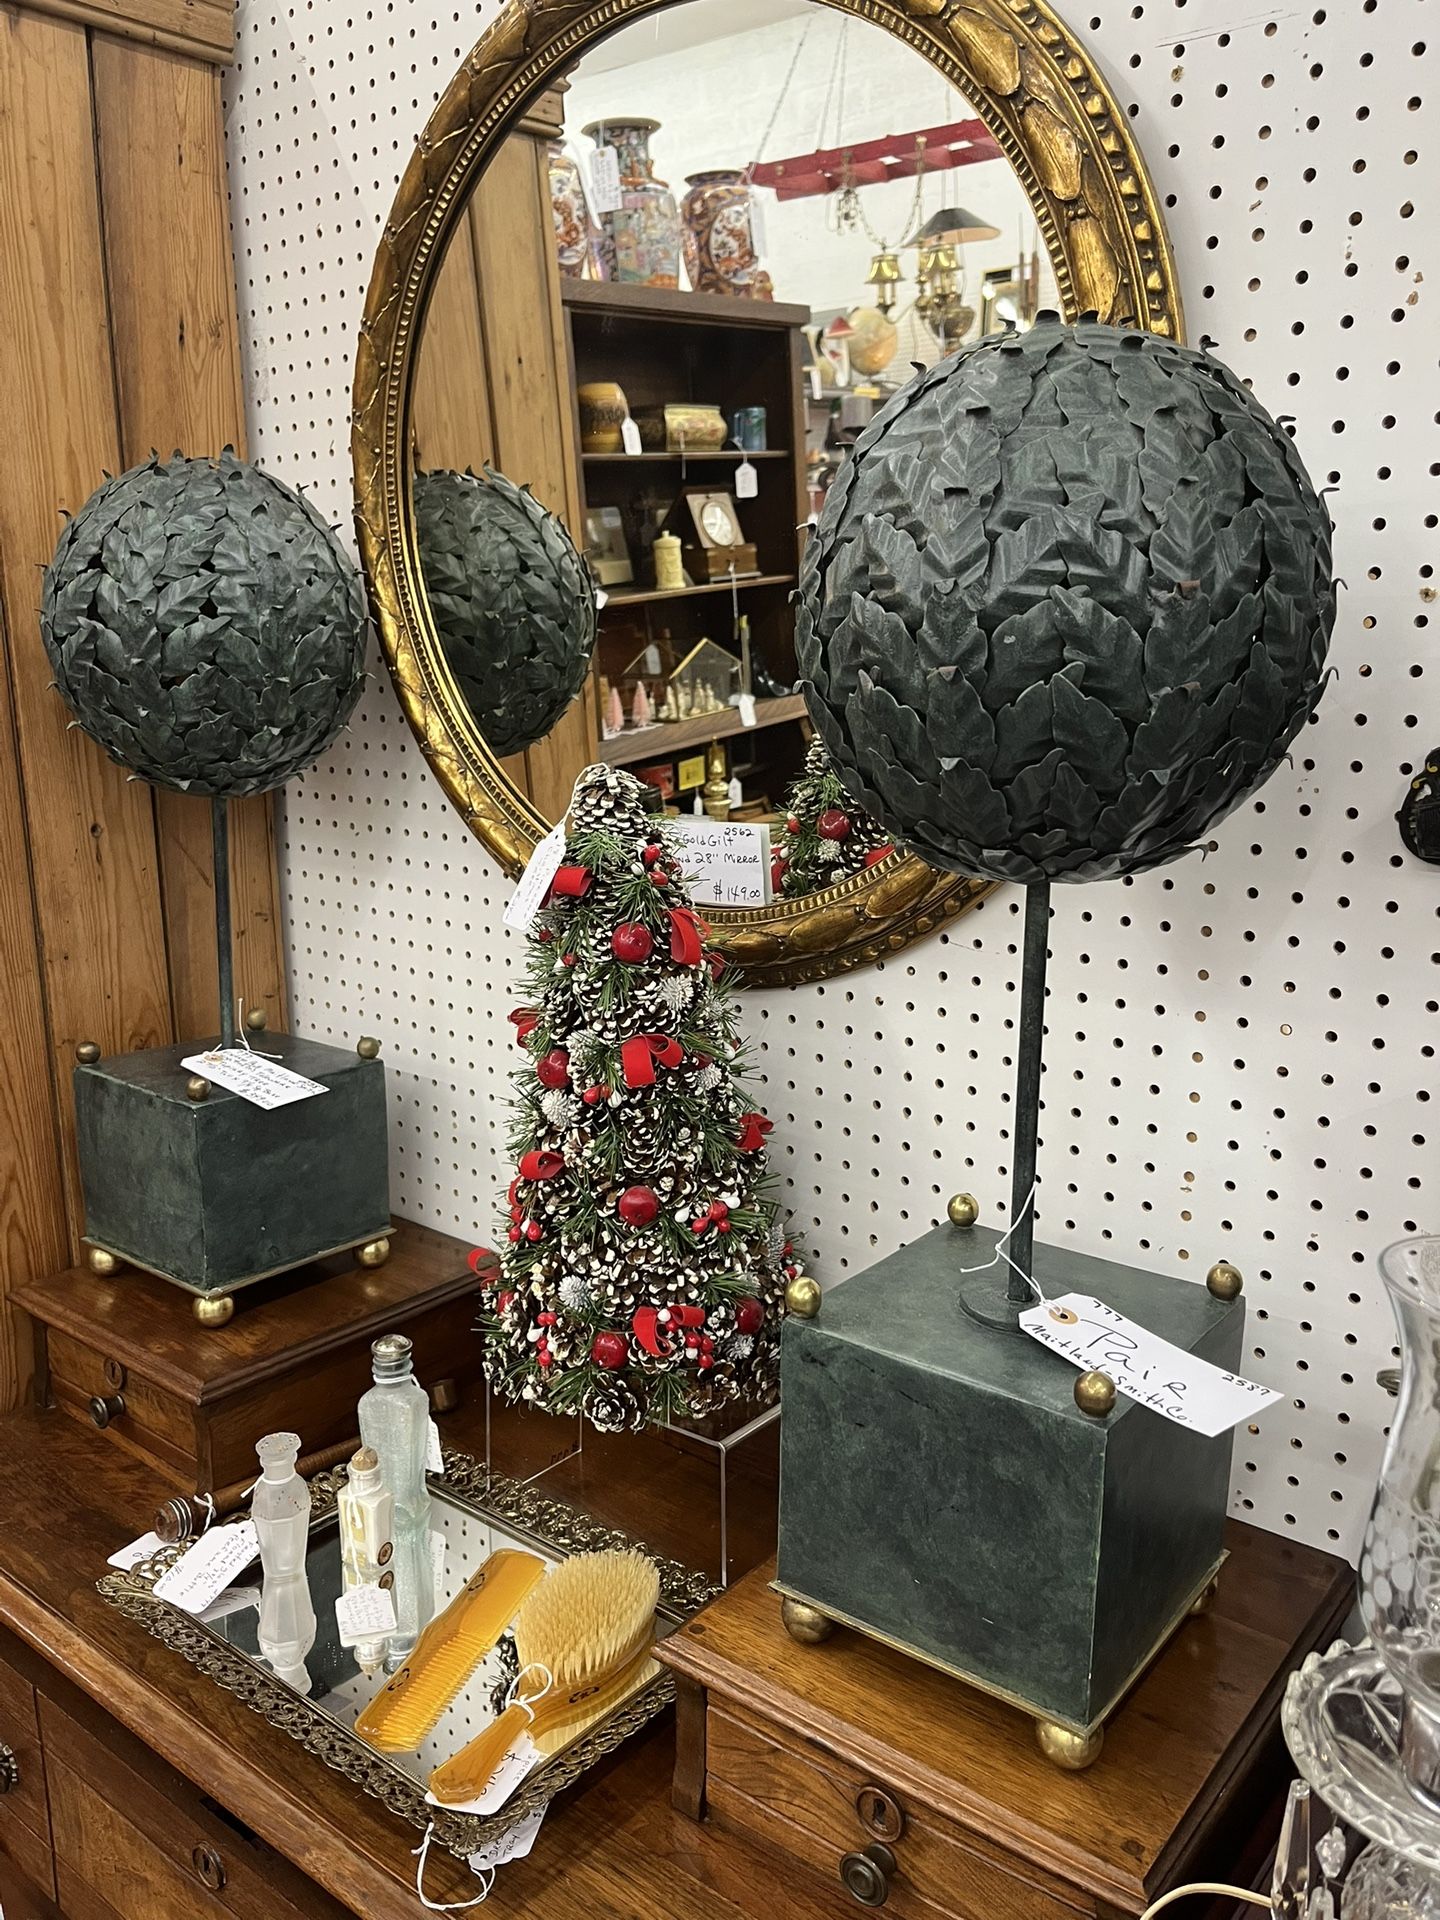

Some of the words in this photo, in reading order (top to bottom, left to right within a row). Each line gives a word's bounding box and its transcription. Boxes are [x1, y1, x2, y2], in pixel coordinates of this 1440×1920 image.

[724, 827, 755, 837] 2562
[1093, 1300, 1123, 1322] 777
[1221, 1374, 1271, 1396] 2587
